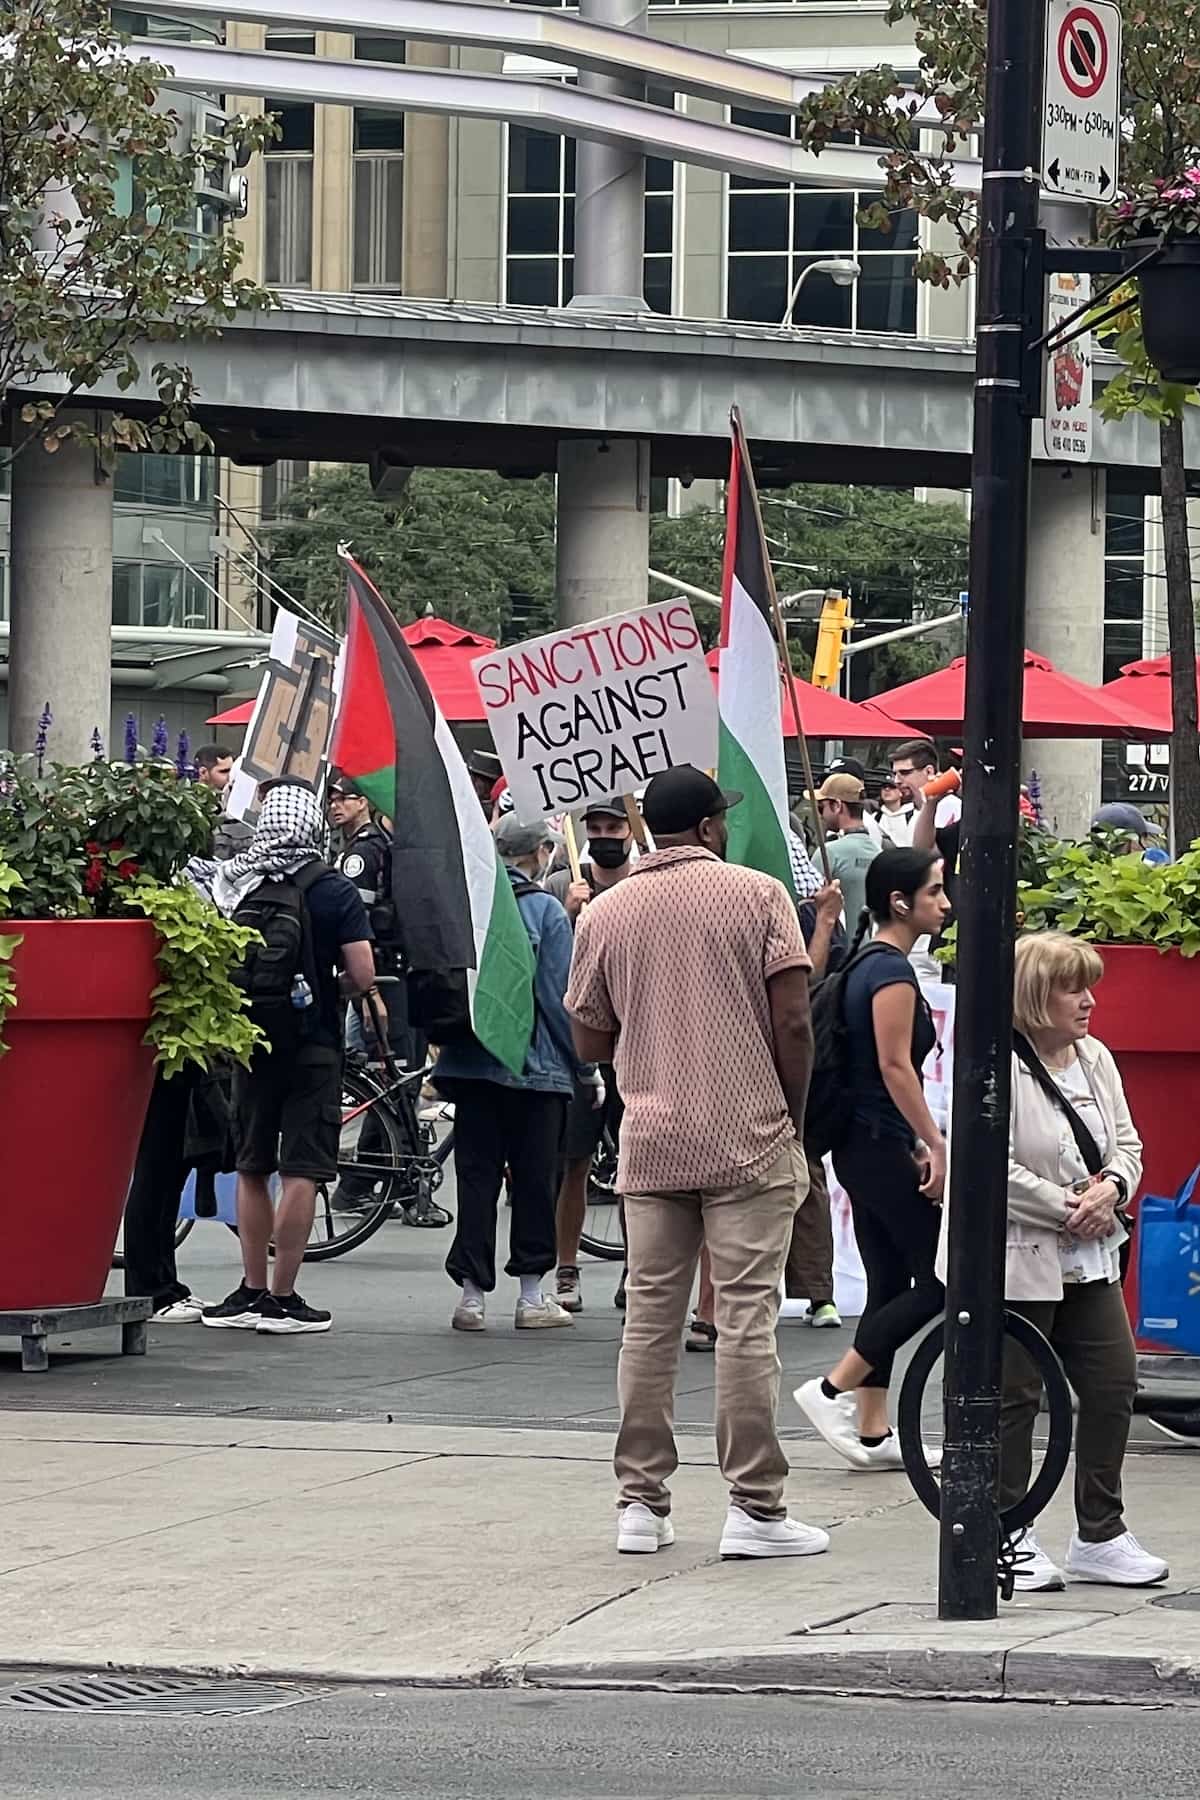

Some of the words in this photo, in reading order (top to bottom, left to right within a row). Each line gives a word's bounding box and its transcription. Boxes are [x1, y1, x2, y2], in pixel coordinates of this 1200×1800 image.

[478, 607, 699, 708] SANCTIONS
[517, 662, 688, 760] AGAINST
[1128, 774, 1157, 792] 277
